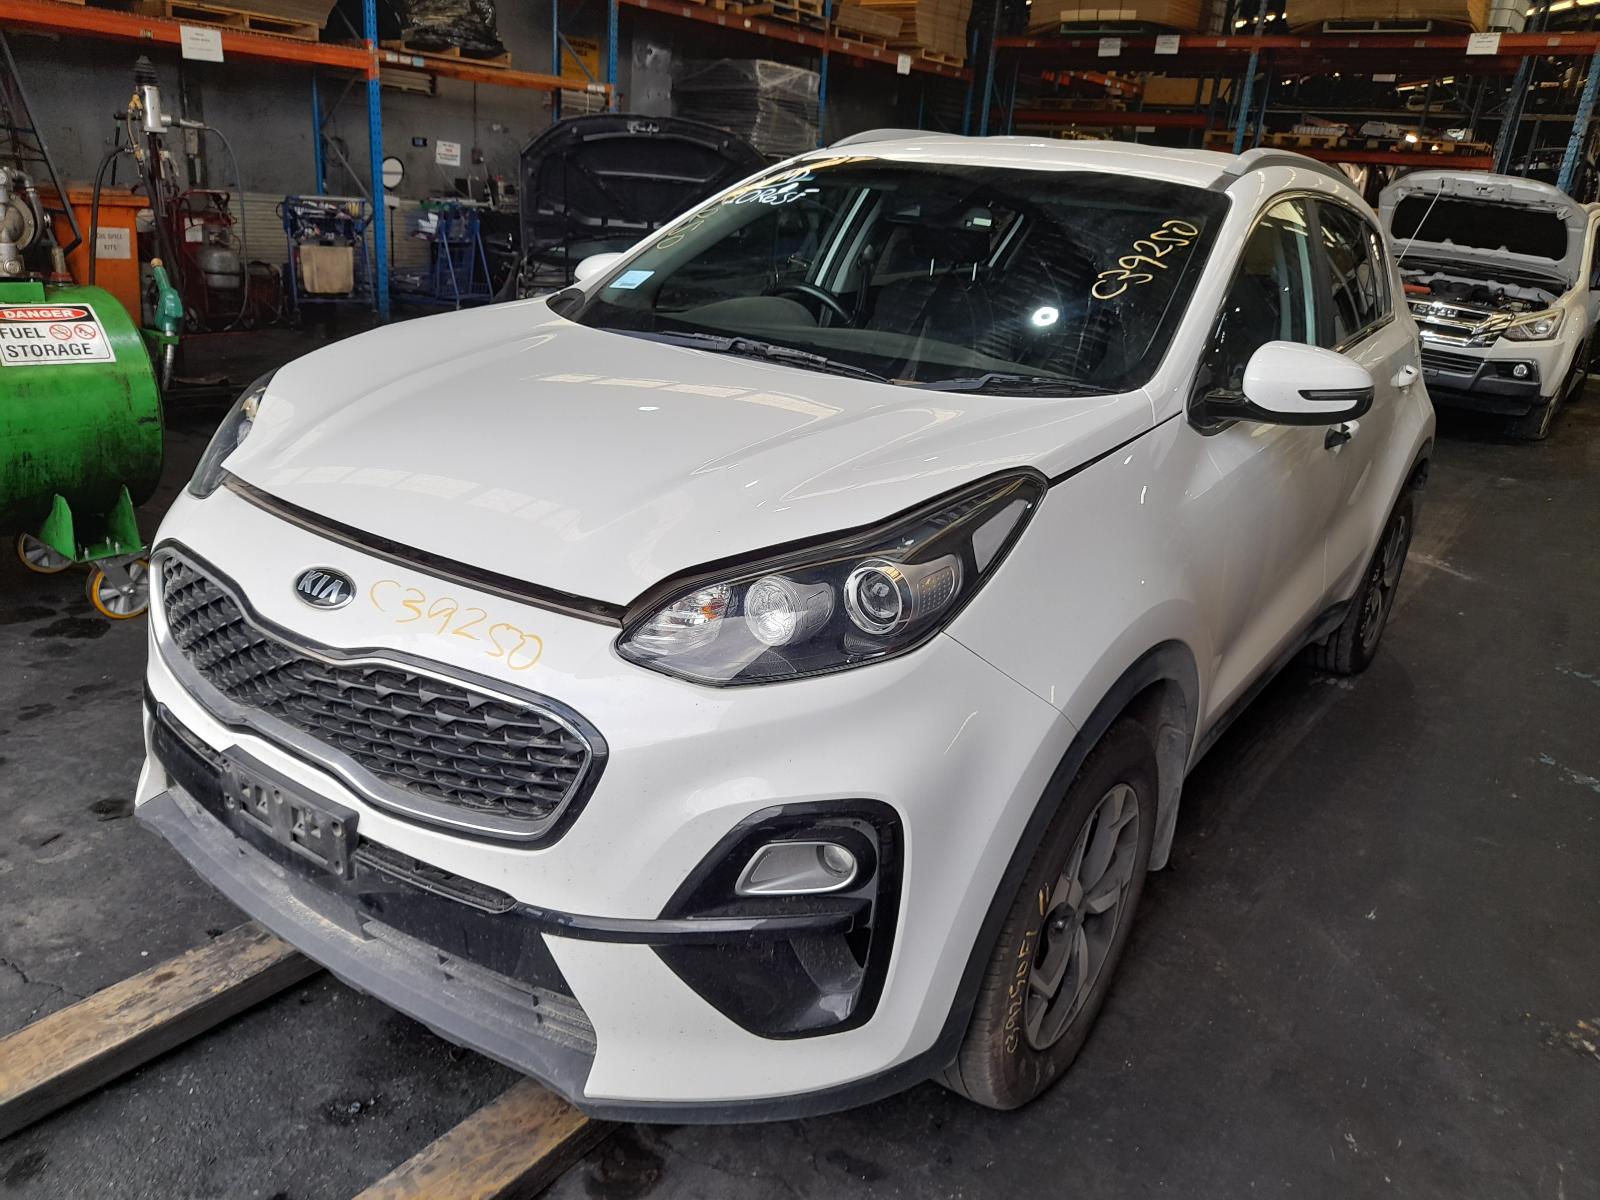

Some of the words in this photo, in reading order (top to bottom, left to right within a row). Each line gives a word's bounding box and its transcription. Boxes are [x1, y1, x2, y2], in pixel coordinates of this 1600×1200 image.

[1091, 220, 1198, 299] C39250
[4, 309, 75, 319] DANGER
[0, 327, 46, 339] FUEL
[6, 343, 94, 358] STORAGE
[297, 569, 343, 605] KIA
[369, 579, 544, 671] C39250
